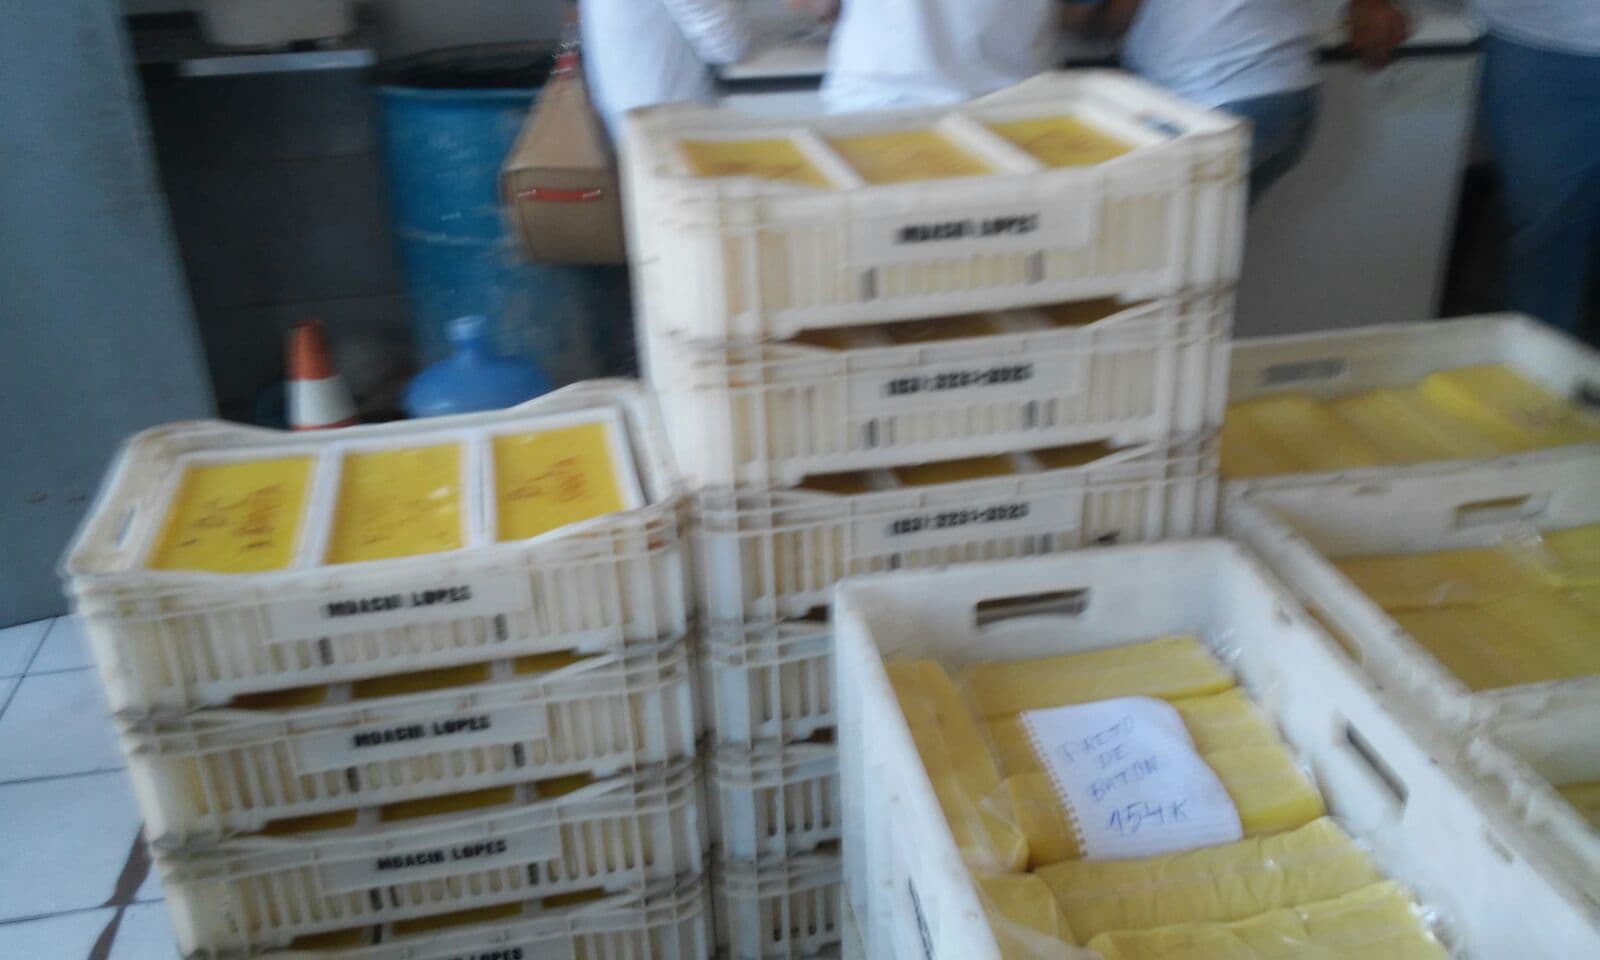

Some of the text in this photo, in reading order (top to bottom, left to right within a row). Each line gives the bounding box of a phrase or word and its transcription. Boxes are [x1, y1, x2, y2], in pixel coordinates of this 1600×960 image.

[411, 585, 473, 608] LOPES
[432, 715, 492, 737] LOPES
[377, 840, 507, 871] MOACIR LOPES
